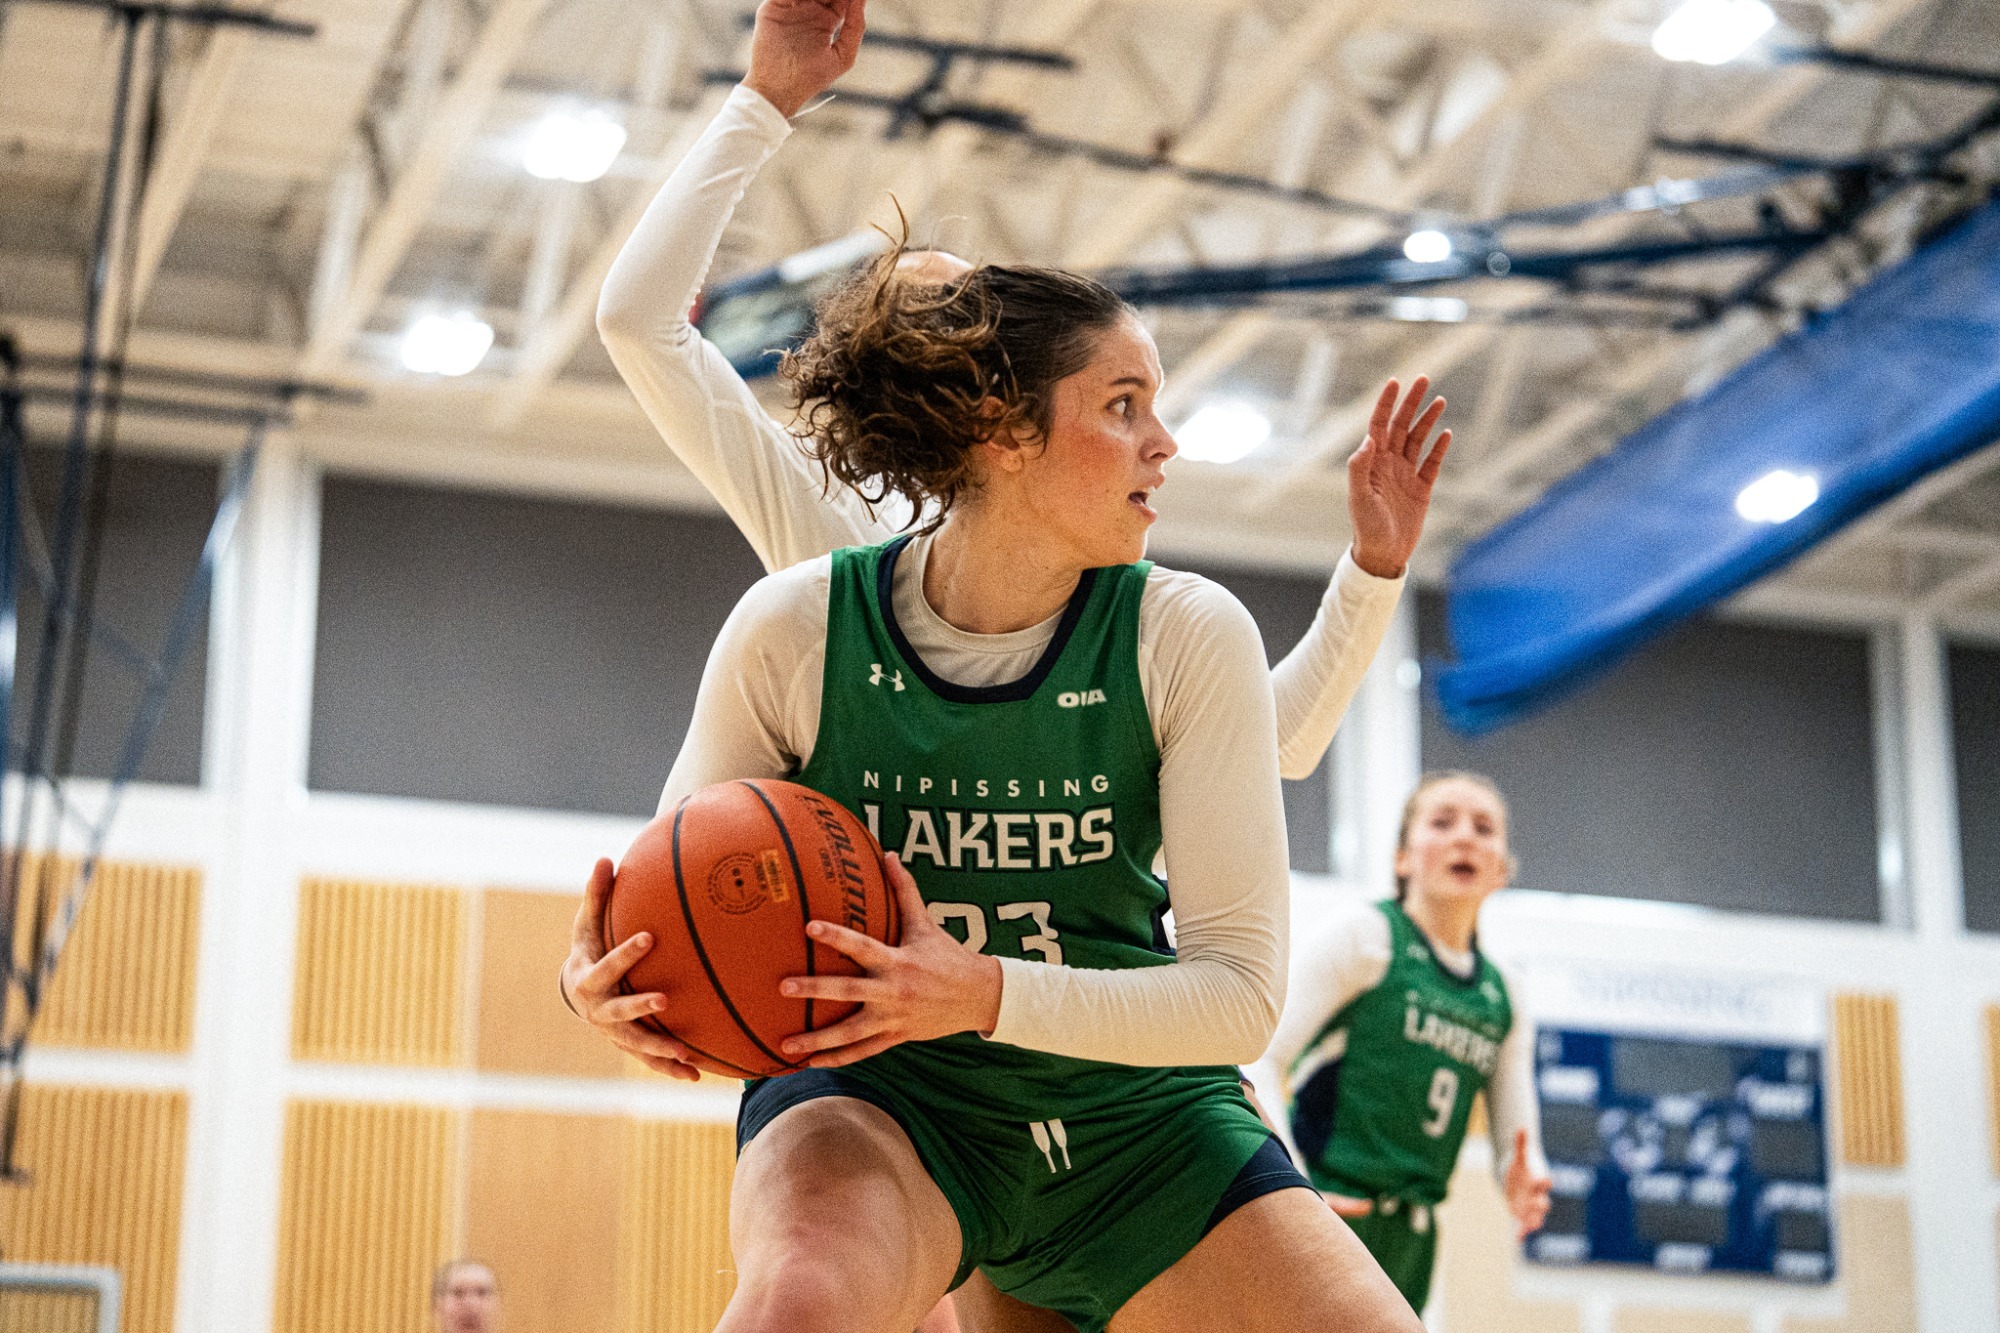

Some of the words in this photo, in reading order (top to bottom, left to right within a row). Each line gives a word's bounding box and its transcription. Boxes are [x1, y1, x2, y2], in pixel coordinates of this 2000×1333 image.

[863, 770, 1109, 798] NIPISSING
[803, 796, 867, 936] EVOLUTIO
[1422, 1067, 1459, 1138] 9
